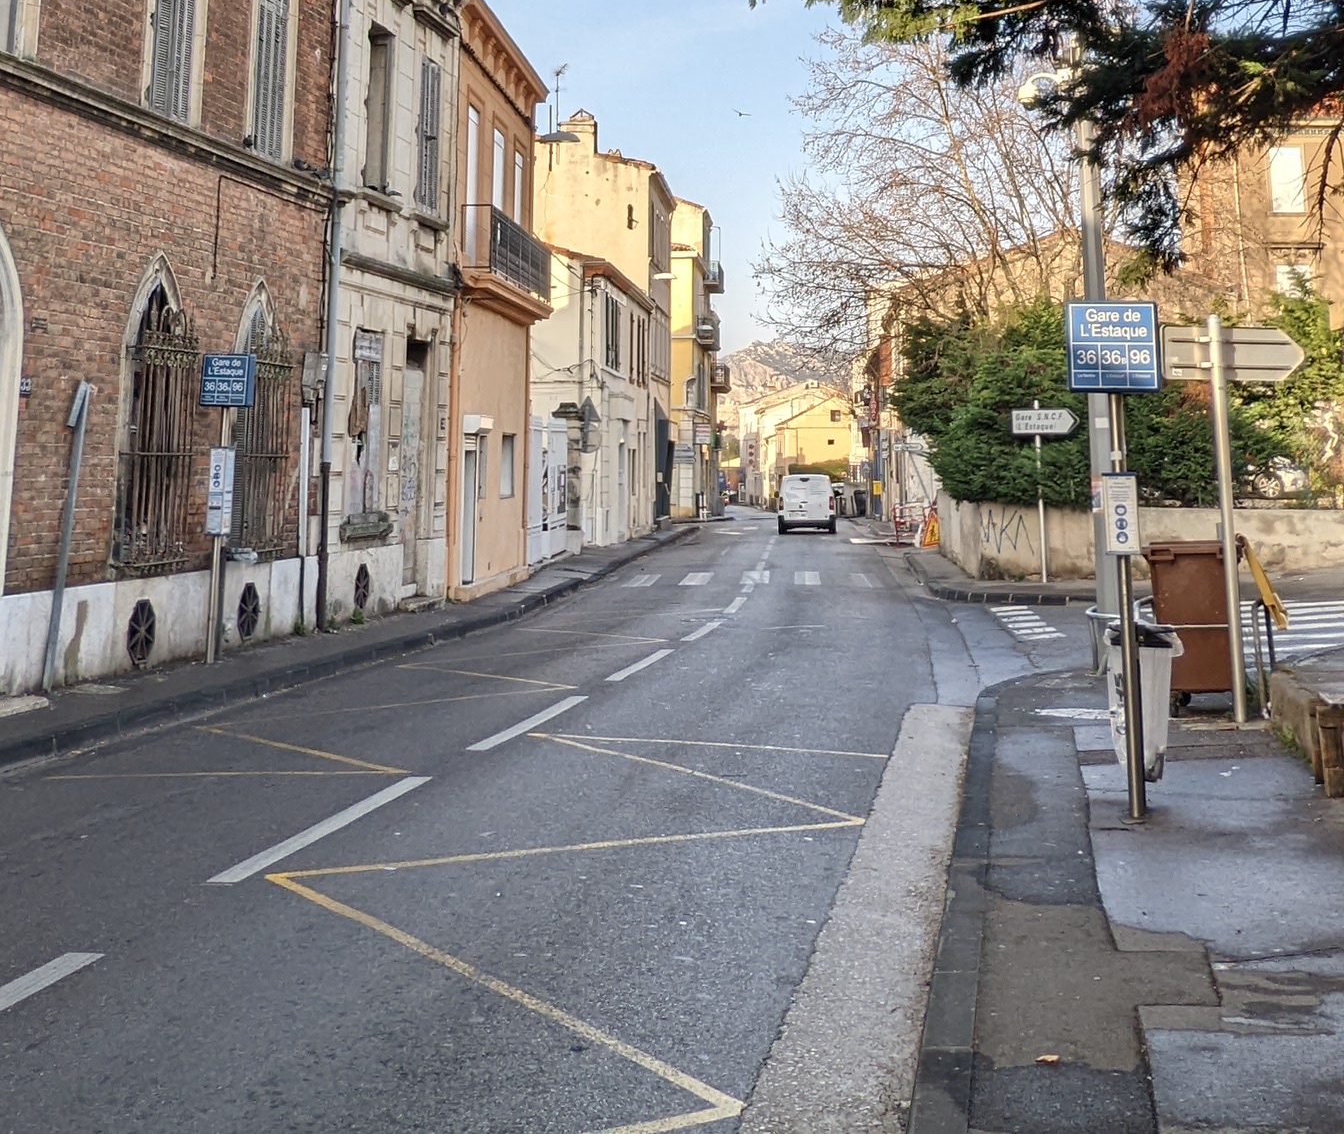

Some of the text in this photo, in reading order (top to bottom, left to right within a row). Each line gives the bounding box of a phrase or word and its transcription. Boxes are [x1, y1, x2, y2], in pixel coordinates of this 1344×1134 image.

[1085, 308, 1141, 322] Gare de
[1080, 323, 1147, 340] L'Estaque
[212, 357, 241, 367] Gare de
[1076, 349, 1096, 365] 36
[1129, 349, 1151, 365] 96
[208, 366, 244, 377] L'Estaque
[204, 381, 215, 391] 36
[232, 382, 243, 392] 96
[1015, 412, 1066, 421] Gare S.N.C.F.
